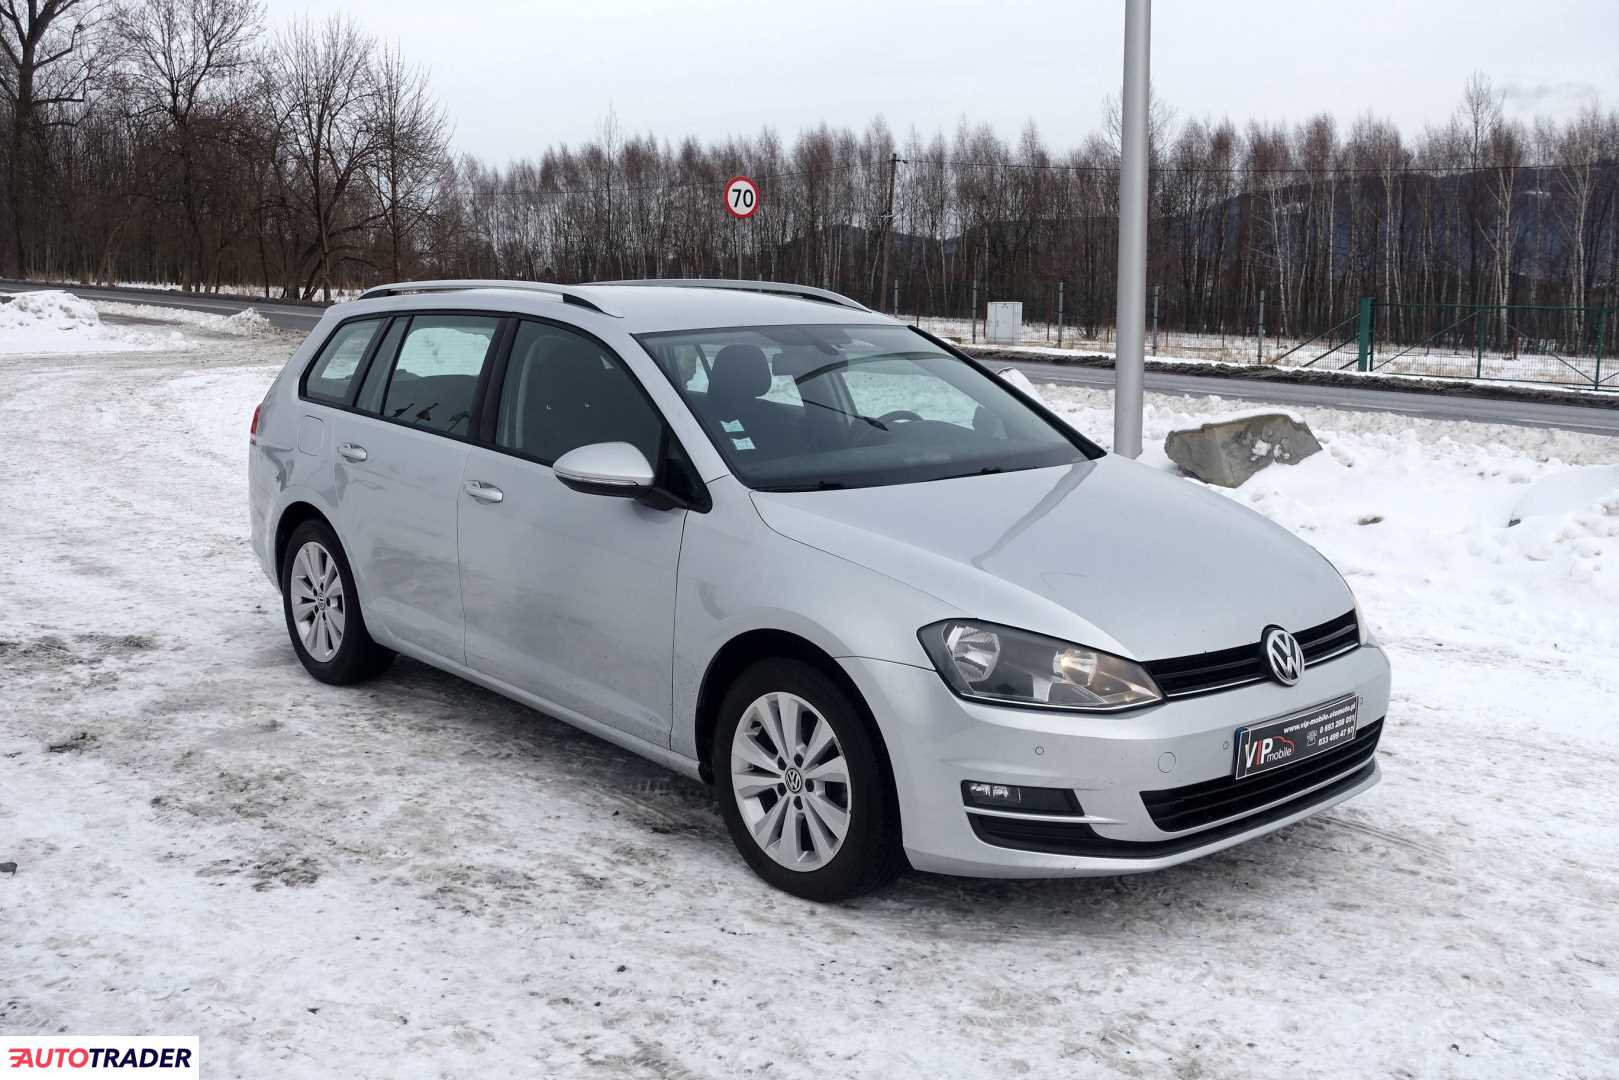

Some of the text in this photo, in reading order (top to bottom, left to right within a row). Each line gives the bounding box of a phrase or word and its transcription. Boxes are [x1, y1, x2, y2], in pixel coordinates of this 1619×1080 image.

[732, 188, 754, 208] 70
[1245, 738, 1274, 768] VIP
[1266, 747, 1293, 763] mobile
